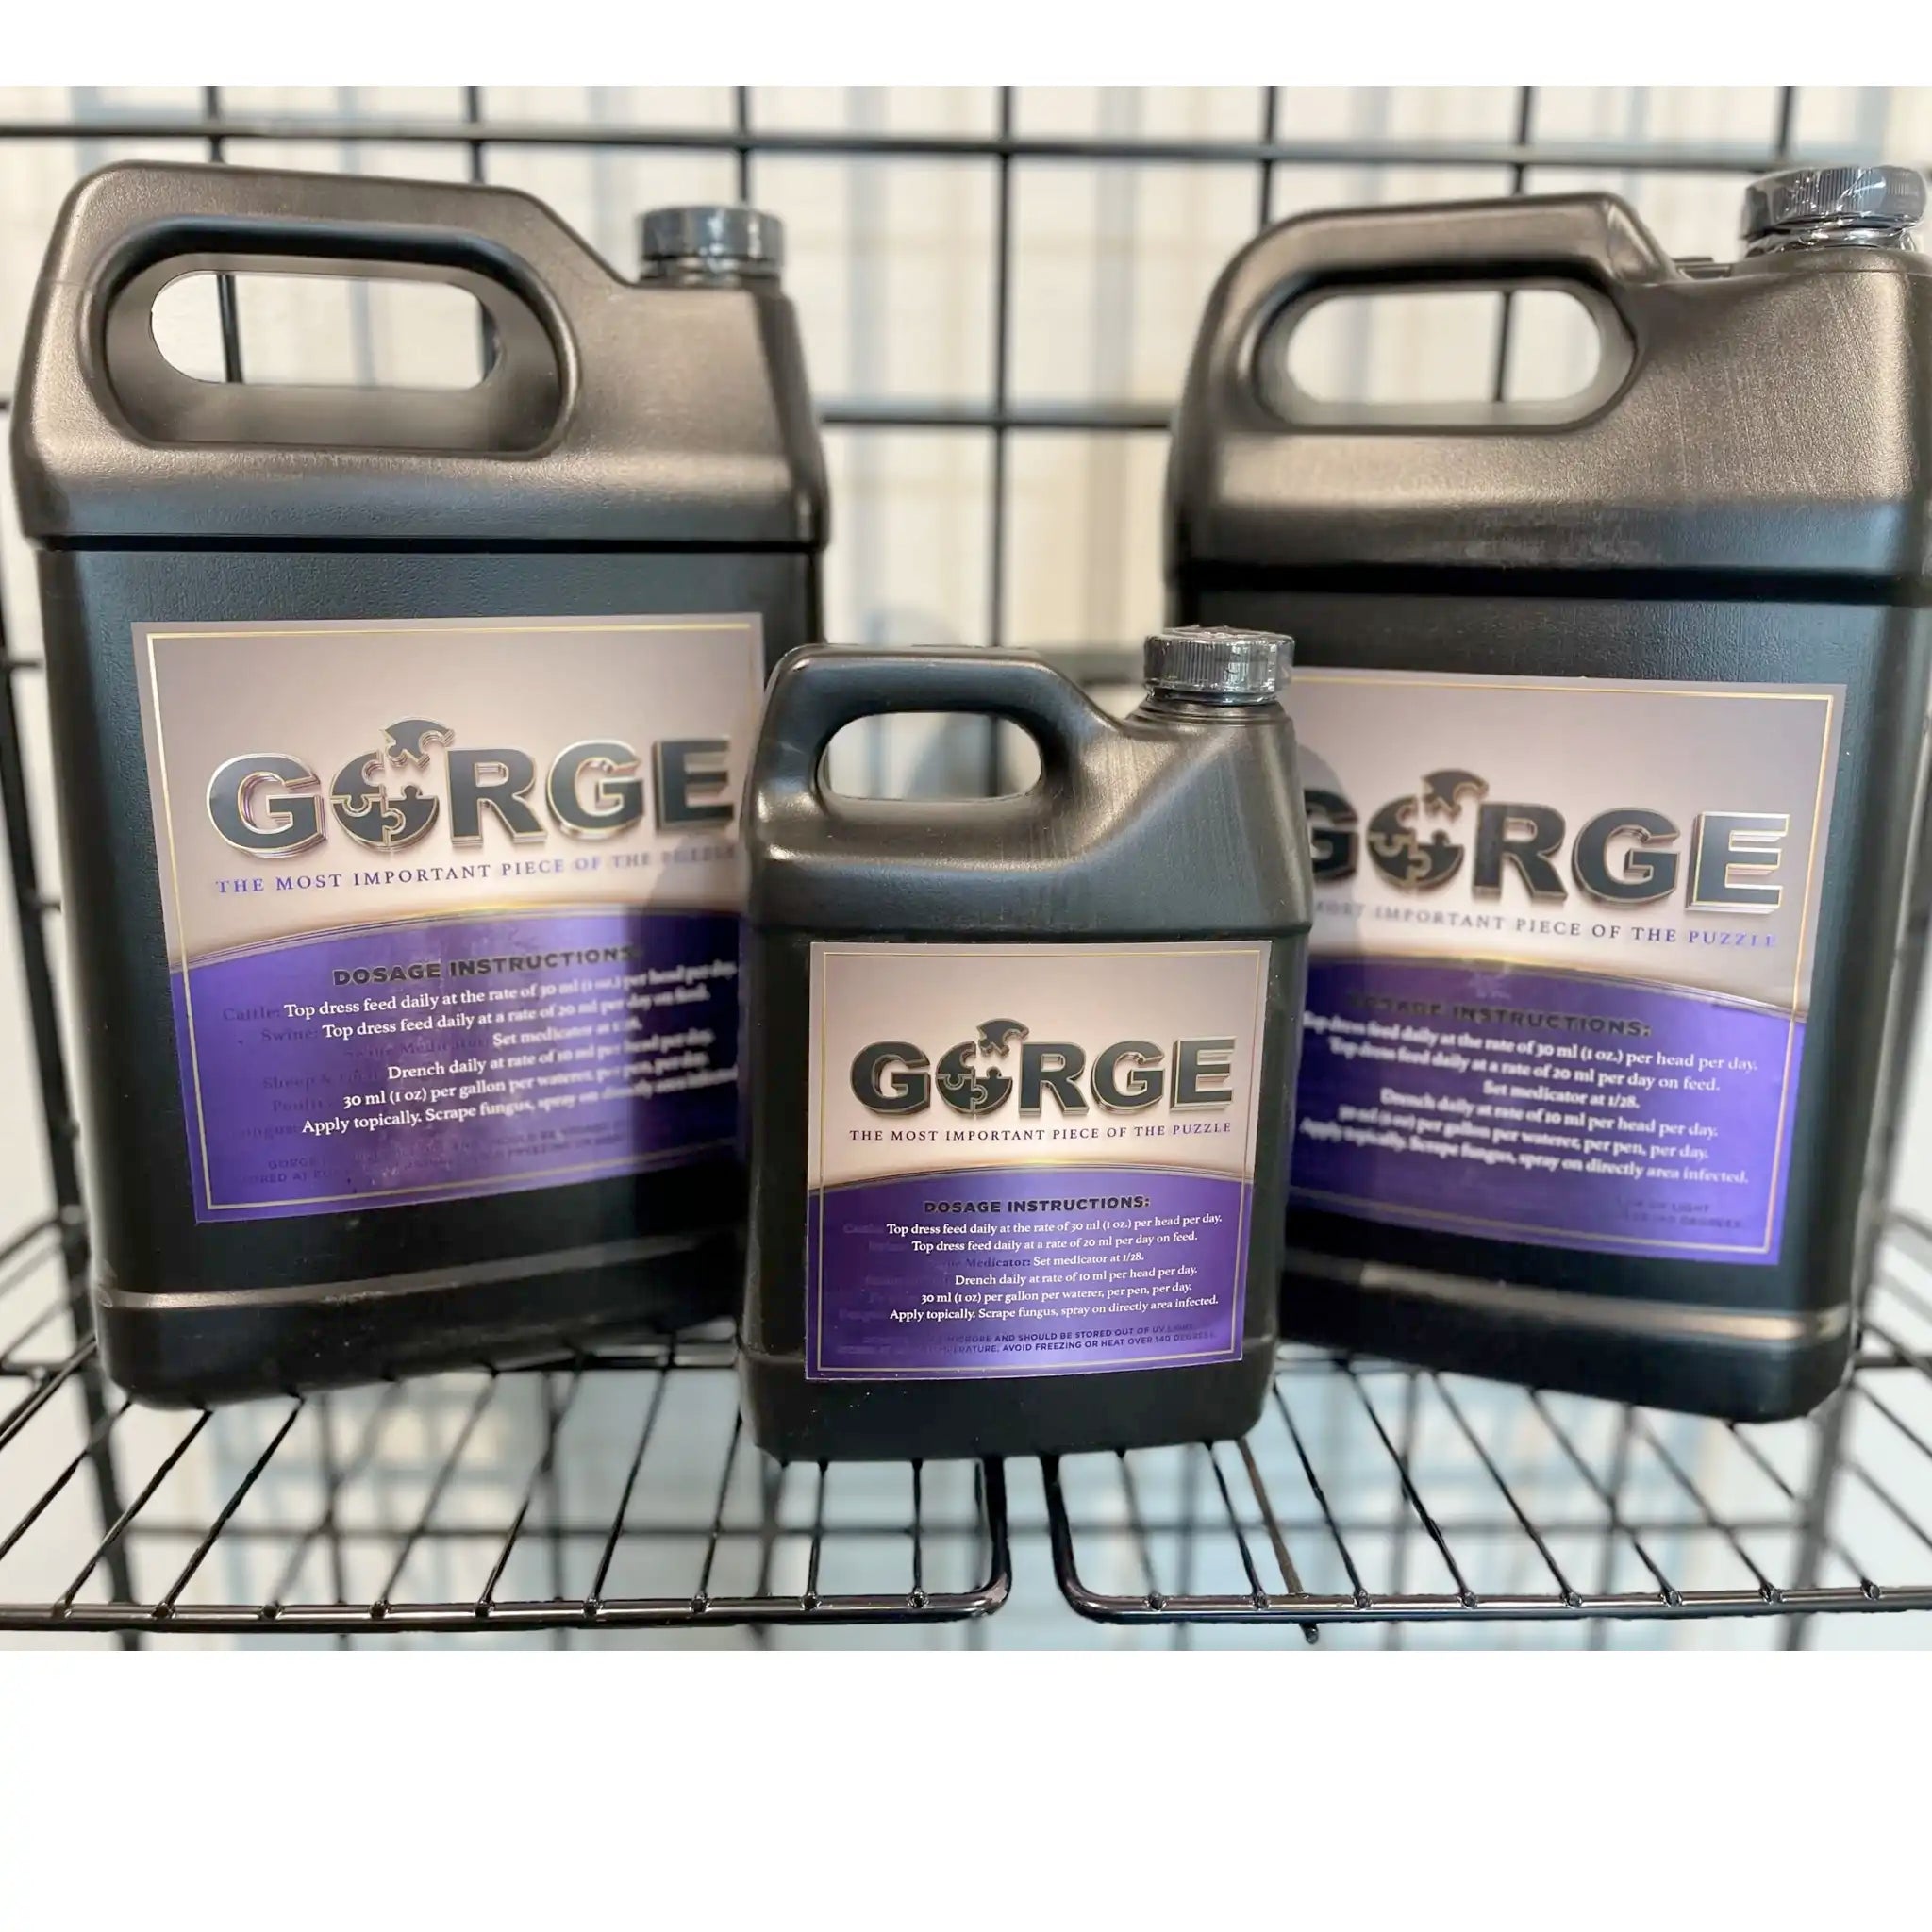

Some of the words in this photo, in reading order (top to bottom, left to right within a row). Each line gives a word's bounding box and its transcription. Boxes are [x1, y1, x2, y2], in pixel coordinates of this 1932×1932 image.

[207, 716, 735, 858] GORGE
[215, 878, 265, 893] THE
[276, 874, 342, 891] MOST
[354, 865, 491, 886] IMPORTANT
[502, 858, 564, 876] PIECE
[575, 857, 601, 871] OF
[1516, 916, 1581, 937] PIECE
[1592, 924, 1621, 938] OF
[1631, 927, 1676, 942] THE
[333, 962, 441, 986] DOSAGE
[283, 1004, 316, 1020] Top
[319, 1001, 360, 1016] dress
[363, 997, 397, 1012] feed
[401, 993, 439, 1010] daily
[442, 992, 458, 1005] at
[460, 989, 484, 1003] the
[489, 989, 516, 1002] rate
[521, 983, 537, 997] of
[322, 1024, 354, 1041] Top
[357, 1021, 396, 1036] dress
[400, 1018, 433, 1032] feed
[437, 1013, 475, 1029] daily
[478, 1012, 492, 1024] at
[495, 1011, 504, 1023] a
[508, 1008, 536, 1022] rate
[492, 1033, 516, 1047] Set
[388, 1061, 445, 1080] Drench
[449, 1058, 487, 1073] daily
[490, 1058, 504, 1068] at
[508, 1055, 536, 1068] rate
[851, 1018, 1237, 1116] GORGE
[1557, 1044, 1577, 1058] ml
[1626, 1053, 1653, 1067] per
[1657, 1052, 1694, 1068] head
[1697, 1058, 1725, 1073] per
[1728, 1056, 1758, 1074] day.
[1574, 1069, 1594, 1083] ml
[1598, 1073, 1624, 1087] per
[1627, 1073, 1655, 1091] day
[1658, 1078, 1678, 1089] on
[1683, 1079, 1720, 1091] feed.
[343, 1096, 361, 1109] 30
[365, 1091, 386, 1105] ml
[389, 1090, 401, 1105] (1
[404, 1087, 426, 1102] oz)
[430, 1087, 456, 1102] per
[459, 1077, 506, 1098] gallon
[302, 1117, 350, 1136] Apply
[353, 1111, 422, 1130] topically.
[425, 1107, 476, 1122] Scrape
[849, 1130, 883, 1141] THE
[891, 1130, 939, 1141] MOST
[946, 1130, 1045, 1141] IMPORTANT
[1053, 1128, 1099, 1140] PIECE
[1107, 1127, 1127, 1138] OF
[1134, 1125, 1165, 1137] THE
[1173, 1123, 1231, 1135] PUZZLE
[1588, 1116, 1615, 1131] per
[1618, 1117, 1655, 1133] head
[1658, 1122, 1685, 1137] per
[1688, 1122, 1718, 1137] day.
[924, 1201, 1001, 1213] DOSAGE
[1008, 1195, 1150, 1213] INSTRUCTIONS:
[887, 1224, 908, 1237] Top
[911, 1224, 941, 1235] dress
[943, 1224, 967, 1234] feed
[970, 1224, 997, 1237] daily
[1000, 1224, 1010, 1233] at
[1012, 1223, 1030, 1233] the
[1034, 1224, 1054, 1233] rate
[1057, 1221, 1070, 1231] of
[1071, 1223, 1083, 1234] 30
[1086, 1220, 1100, 1230] ml
[1103, 1220, 1111, 1232] (1
[1113, 1219, 1132, 1229] oz.)
[1134, 1219, 1152, 1231] per
[1155, 1215, 1180, 1226] head
[1182, 1215, 1200, 1227] per
[1202, 1212, 1223, 1224] day.
[911, 1241, 934, 1255] Top
[936, 1241, 965, 1252] dress
[967, 1241, 991, 1251] feed
[993, 1241, 1022, 1253] daily
[1024, 1241, 1035, 1250] at
[1038, 1241, 1043, 1249] a
[1045, 1240, 1068, 1249] rate
[1070, 1238, 1081, 1248] of
[1084, 1239, 1096, 1248] 20
[1098, 1237, 1112, 1246] ml
[1115, 1237, 1133, 1248] per
[1135, 1234, 1155, 1247] day
[1157, 1235, 1170, 1243] on
[1173, 1231, 1198, 1242] feed.
[966, 1257, 1031, 1269] Medicator:
[1034, 1257, 1050, 1267] Set
[1053, 1253, 1108, 1266] medicator
[1110, 1255, 1121, 1263] at
[1123, 1252, 1144, 1262] 1/28.
[955, 1274, 996, 1286] Drench
[999, 1274, 1027, 1288] daily
[1042, 1274, 1064, 1283] rate
[1065, 1272, 1078, 1282] of
[1079, 1273, 1091, 1281] 10
[1092, 1271, 1108, 1281] ml
[1109, 1270, 1127, 1282] per
[1129, 1267, 1156, 1278] head
[1158, 1267, 1175, 1279] per
[1177, 1265, 1198, 1275] day.
[921, 1292, 934, 1305] 30
[936, 1291, 952, 1303] ml
[954, 1291, 962, 1305] (1
[965, 1291, 982, 1305] oz)
[984, 1293, 1003, 1305] per
[1005, 1291, 1039, 1304] gallon
[1041, 1291, 1059, 1303] per
[1062, 1289, 1105, 1299] waterer,
[1107, 1287, 1125, 1299] per
[1127, 1287, 1150, 1298] pen,
[1152, 1285, 1170, 1297] per
[1172, 1282, 1191, 1293] day.
[890, 1309, 923, 1323] Apply
[926, 1309, 975, 1322] topically.
[978, 1307, 1015, 1321] Scrape
[1018, 1307, 1059, 1319] fungus,
[1060, 1307, 1090, 1318] spray
[1092, 1304, 1107, 1314] on
[1108, 1302, 1149, 1314] directly
[1150, 1301, 1173, 1310] area
[1174, 1295, 1219, 1307] infected.
[995, 1334, 1015, 1342] AND
[1018, 1332, 1058, 1341] SHOULD
[1059, 1331, 1072, 1340] BE
[1074, 1329, 1112, 1339] STORED
[1114, 1328, 1134, 1337] OUT
[1136, 1326, 1149, 1335] OF
[1003, 1344, 1032, 1353] AVOID
[1035, 1341, 1082, 1351] FREEZING
[1085, 1340, 1098, 1348] OR
[1101, 1338, 1124, 1347] HEAT
[1127, 1336, 1153, 1345] OVER
